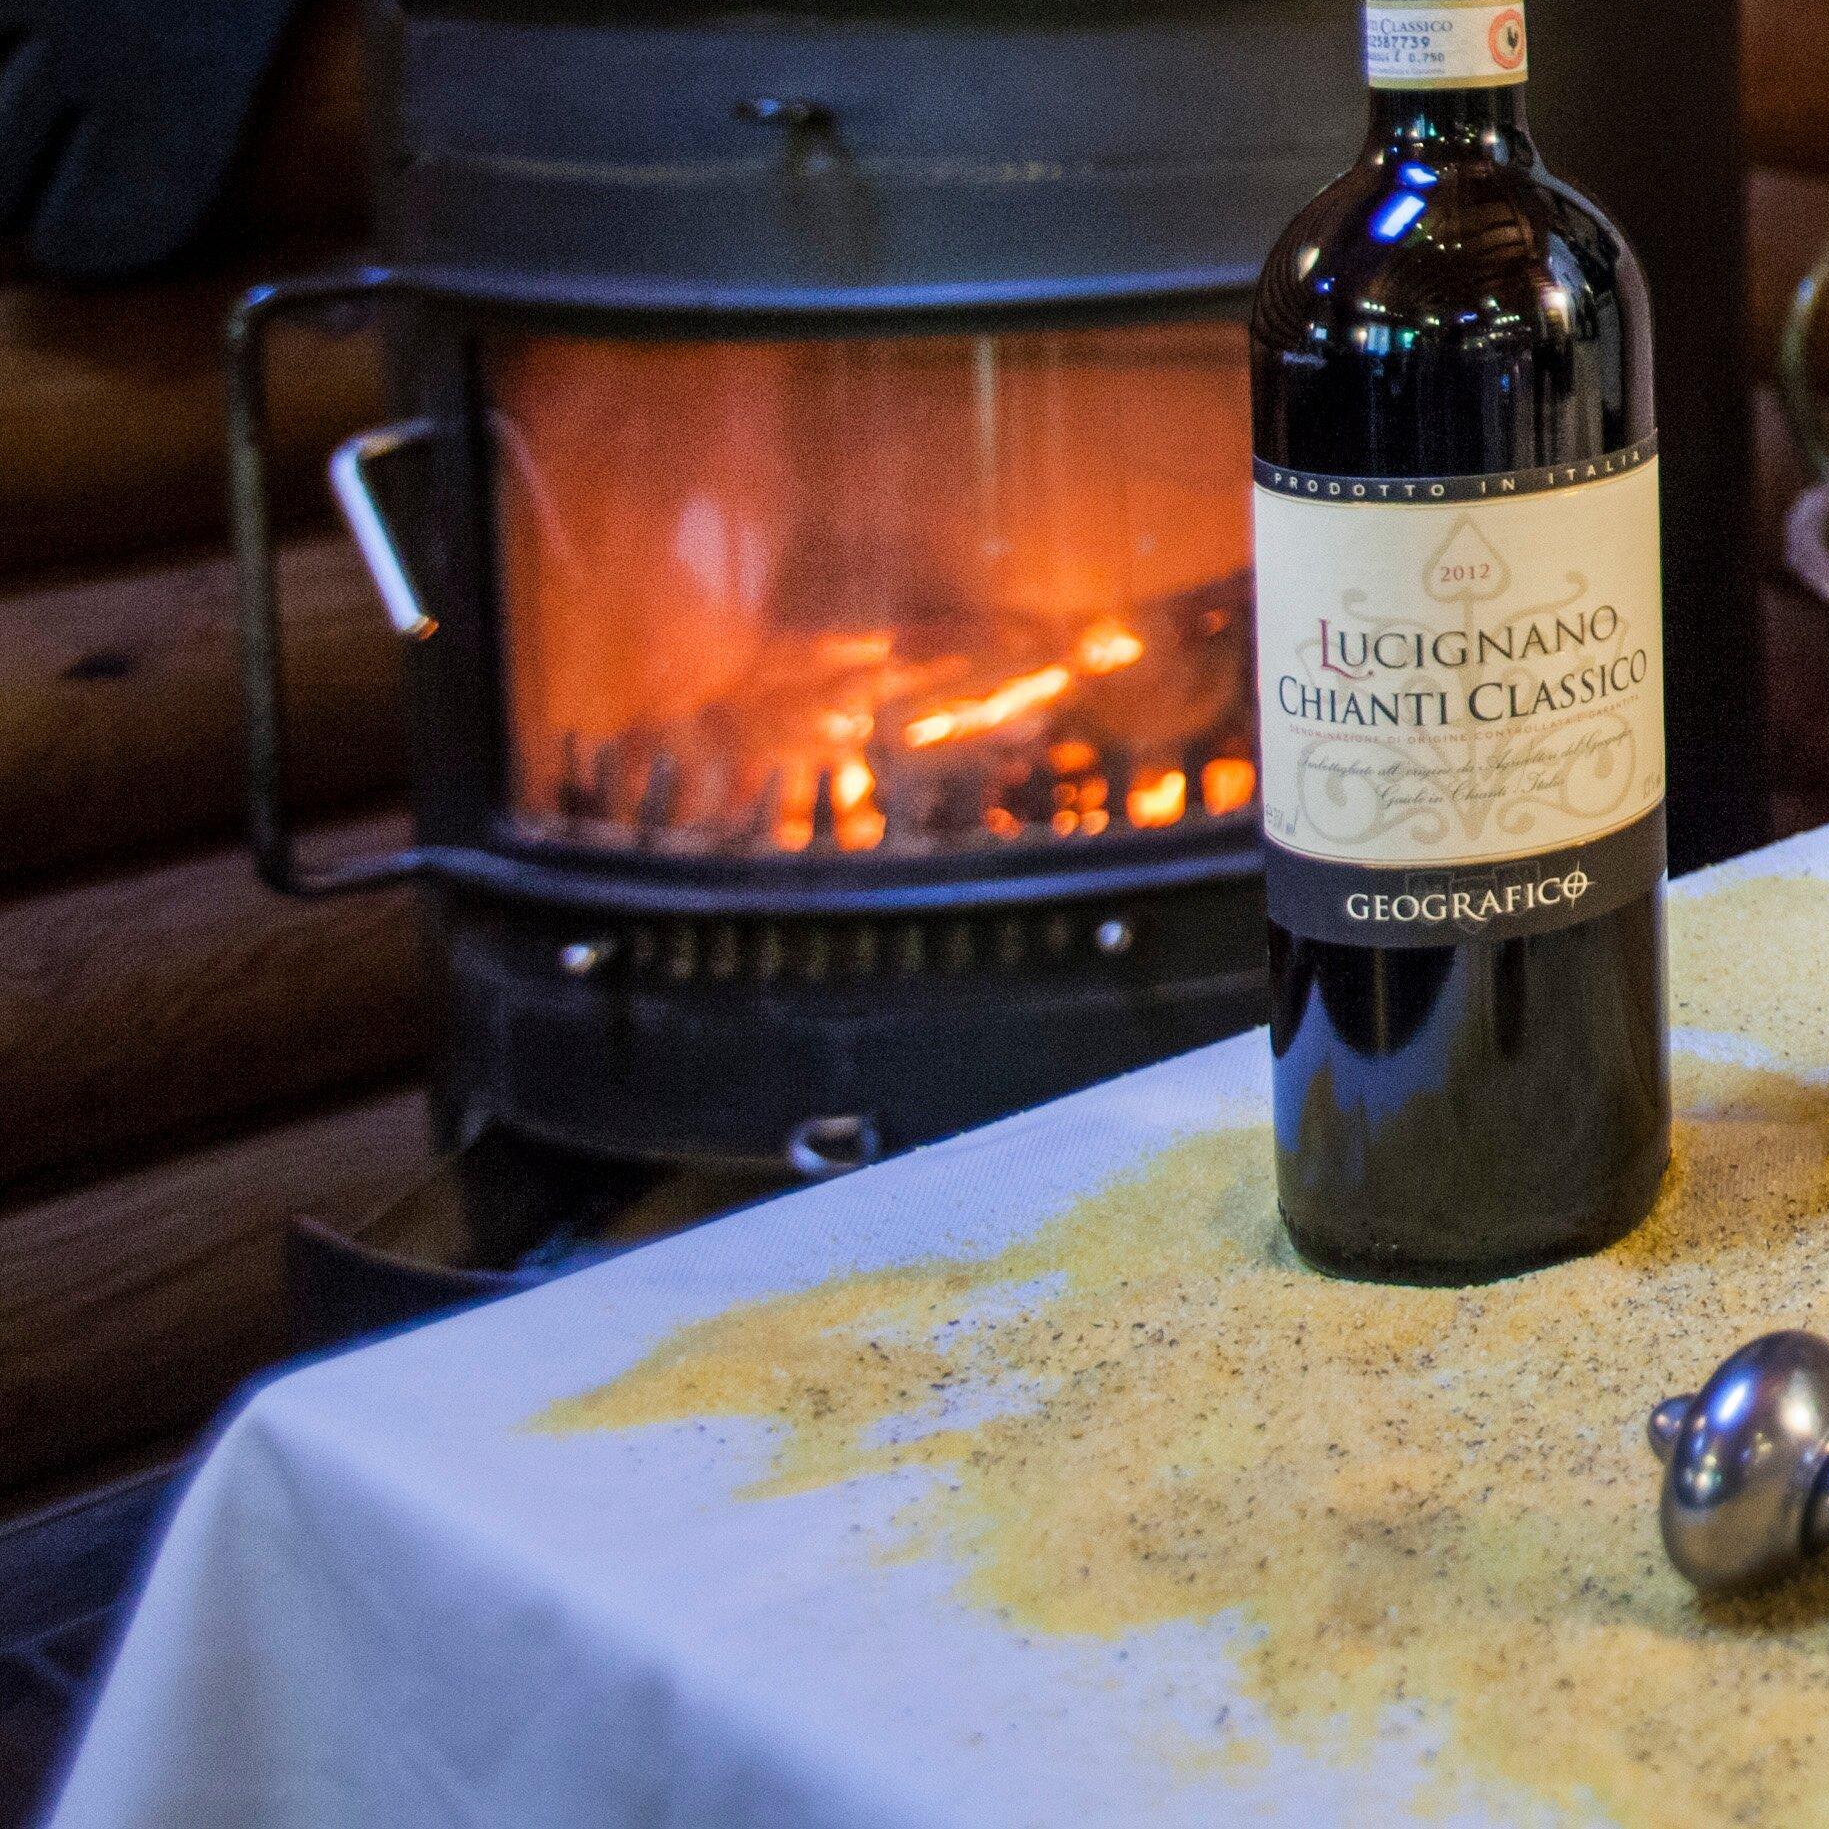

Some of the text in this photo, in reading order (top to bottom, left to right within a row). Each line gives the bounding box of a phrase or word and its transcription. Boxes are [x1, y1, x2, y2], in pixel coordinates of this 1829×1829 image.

[1380, 18, 1453, 35] CLASSICO
[1274, 451, 1640, 497] PRODOTTO IN ITALIA
[1440, 563, 1491, 583] 2012
[1318, 604, 1618, 681] LUCIGNANO
[1278, 648, 1648, 727] CHIANTI CLASSICO
[1346, 863, 1592, 923] GEOGRAFICO
